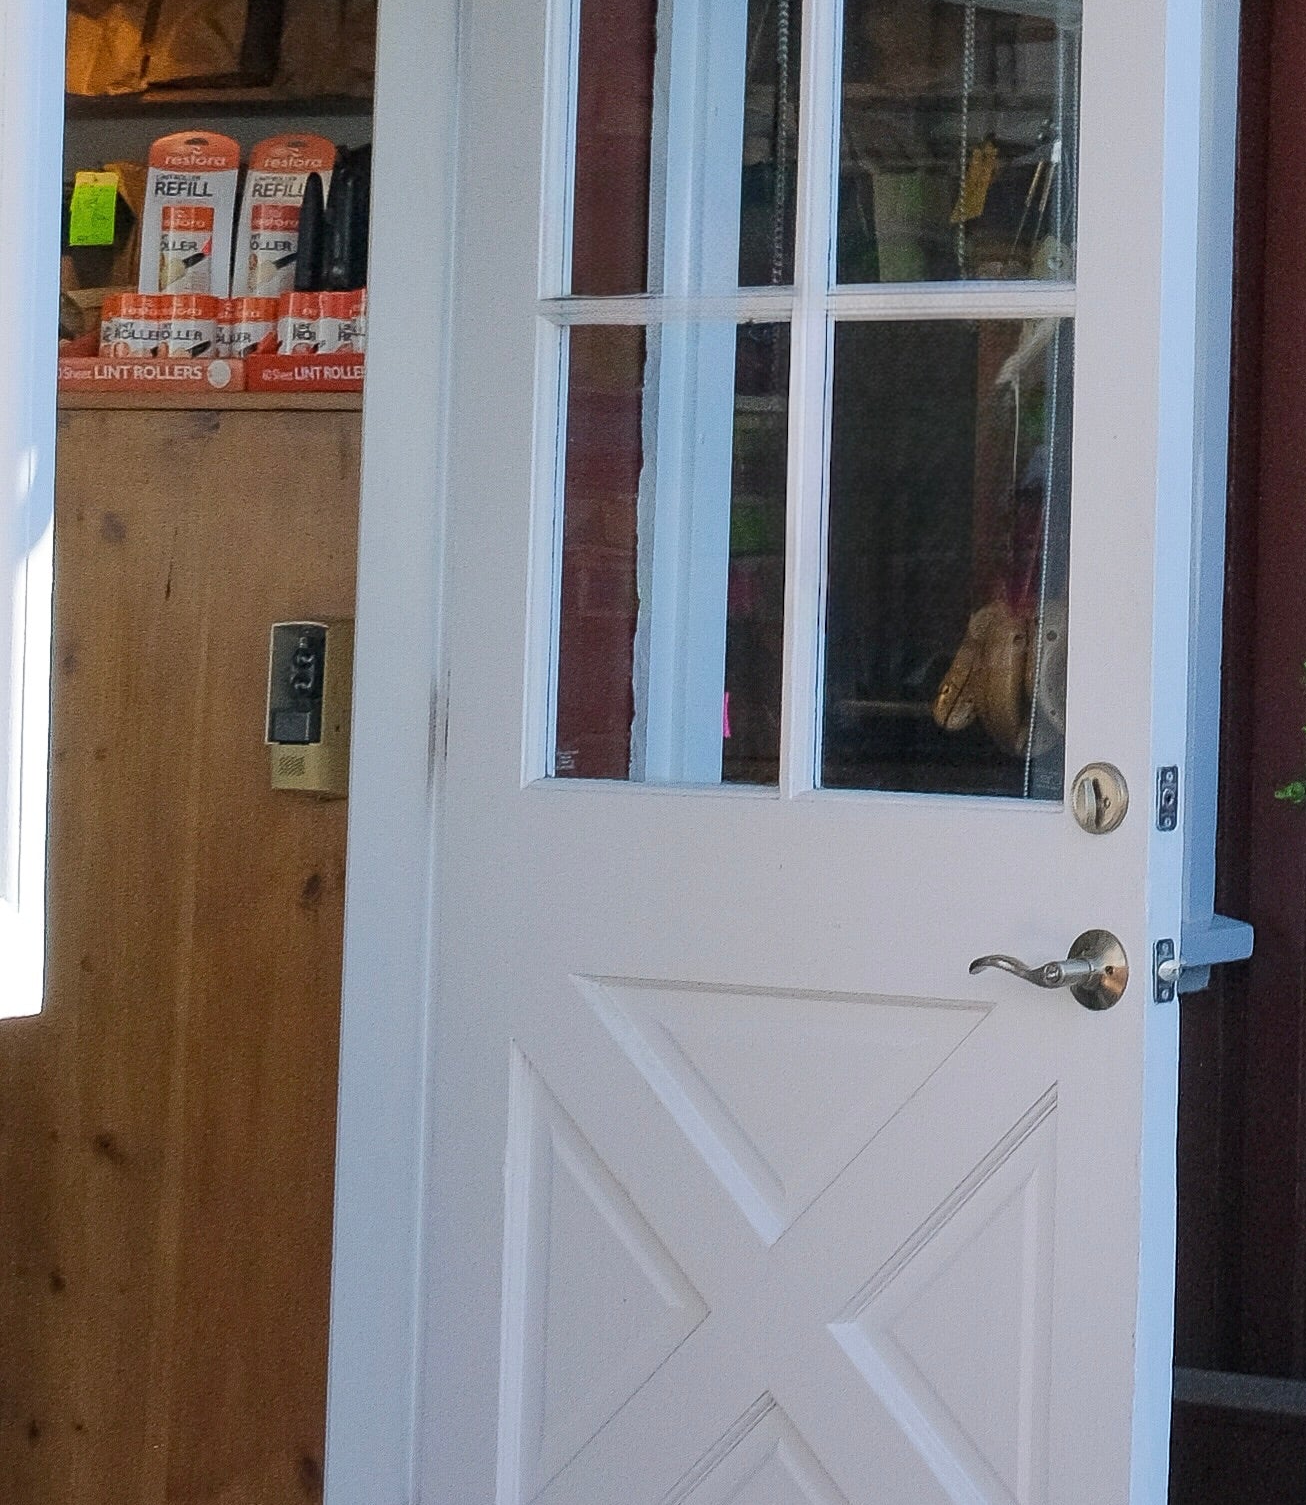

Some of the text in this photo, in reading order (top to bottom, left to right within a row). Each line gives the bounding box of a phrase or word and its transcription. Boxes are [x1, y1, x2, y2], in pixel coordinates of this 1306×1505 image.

[165, 154, 226, 166] restora
[264, 157, 323, 168] restora
[155, 181, 213, 197] REFILL
[252, 183, 305, 197] REFILL
[94, 365, 131, 379] LINT
[133, 365, 203, 379] ROLLERS
[294, 366, 322, 380] LINT
[323, 365, 363, 379] ROLLE
